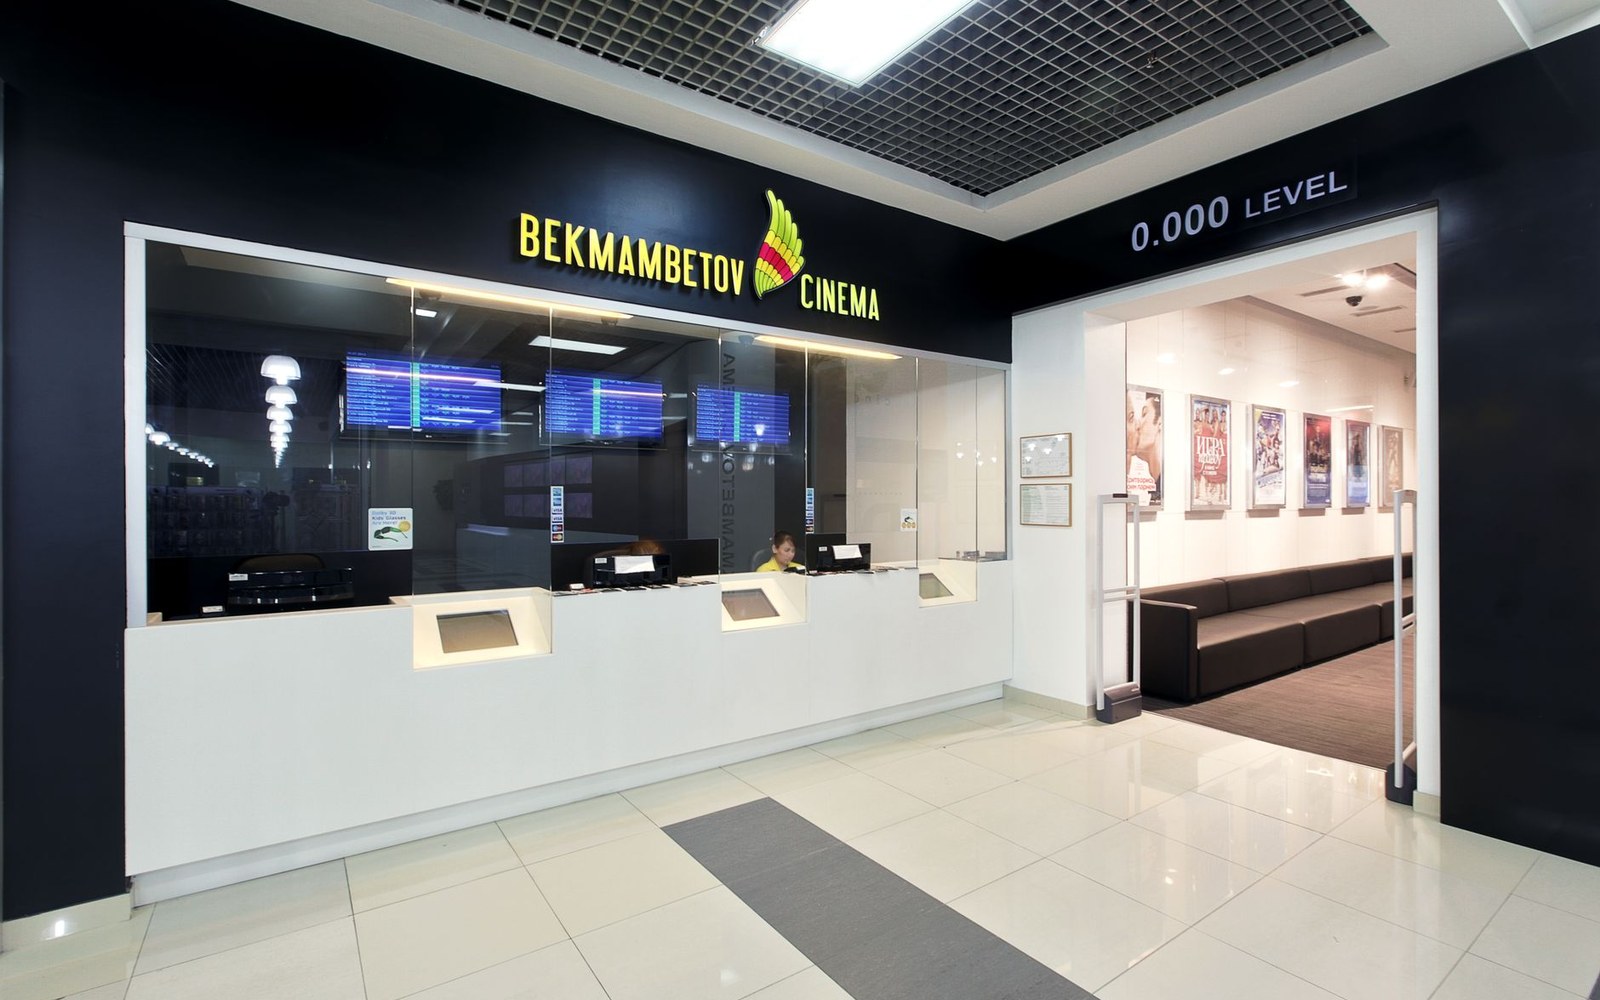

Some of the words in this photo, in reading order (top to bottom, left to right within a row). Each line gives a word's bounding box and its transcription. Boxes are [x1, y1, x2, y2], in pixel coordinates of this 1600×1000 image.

[1131, 196, 1229, 251] 0.000
[1245, 171, 1348, 218] LEVEL
[519, 212, 744, 296] BEKMAMBETOV
[800, 273, 880, 321] CINEMA
